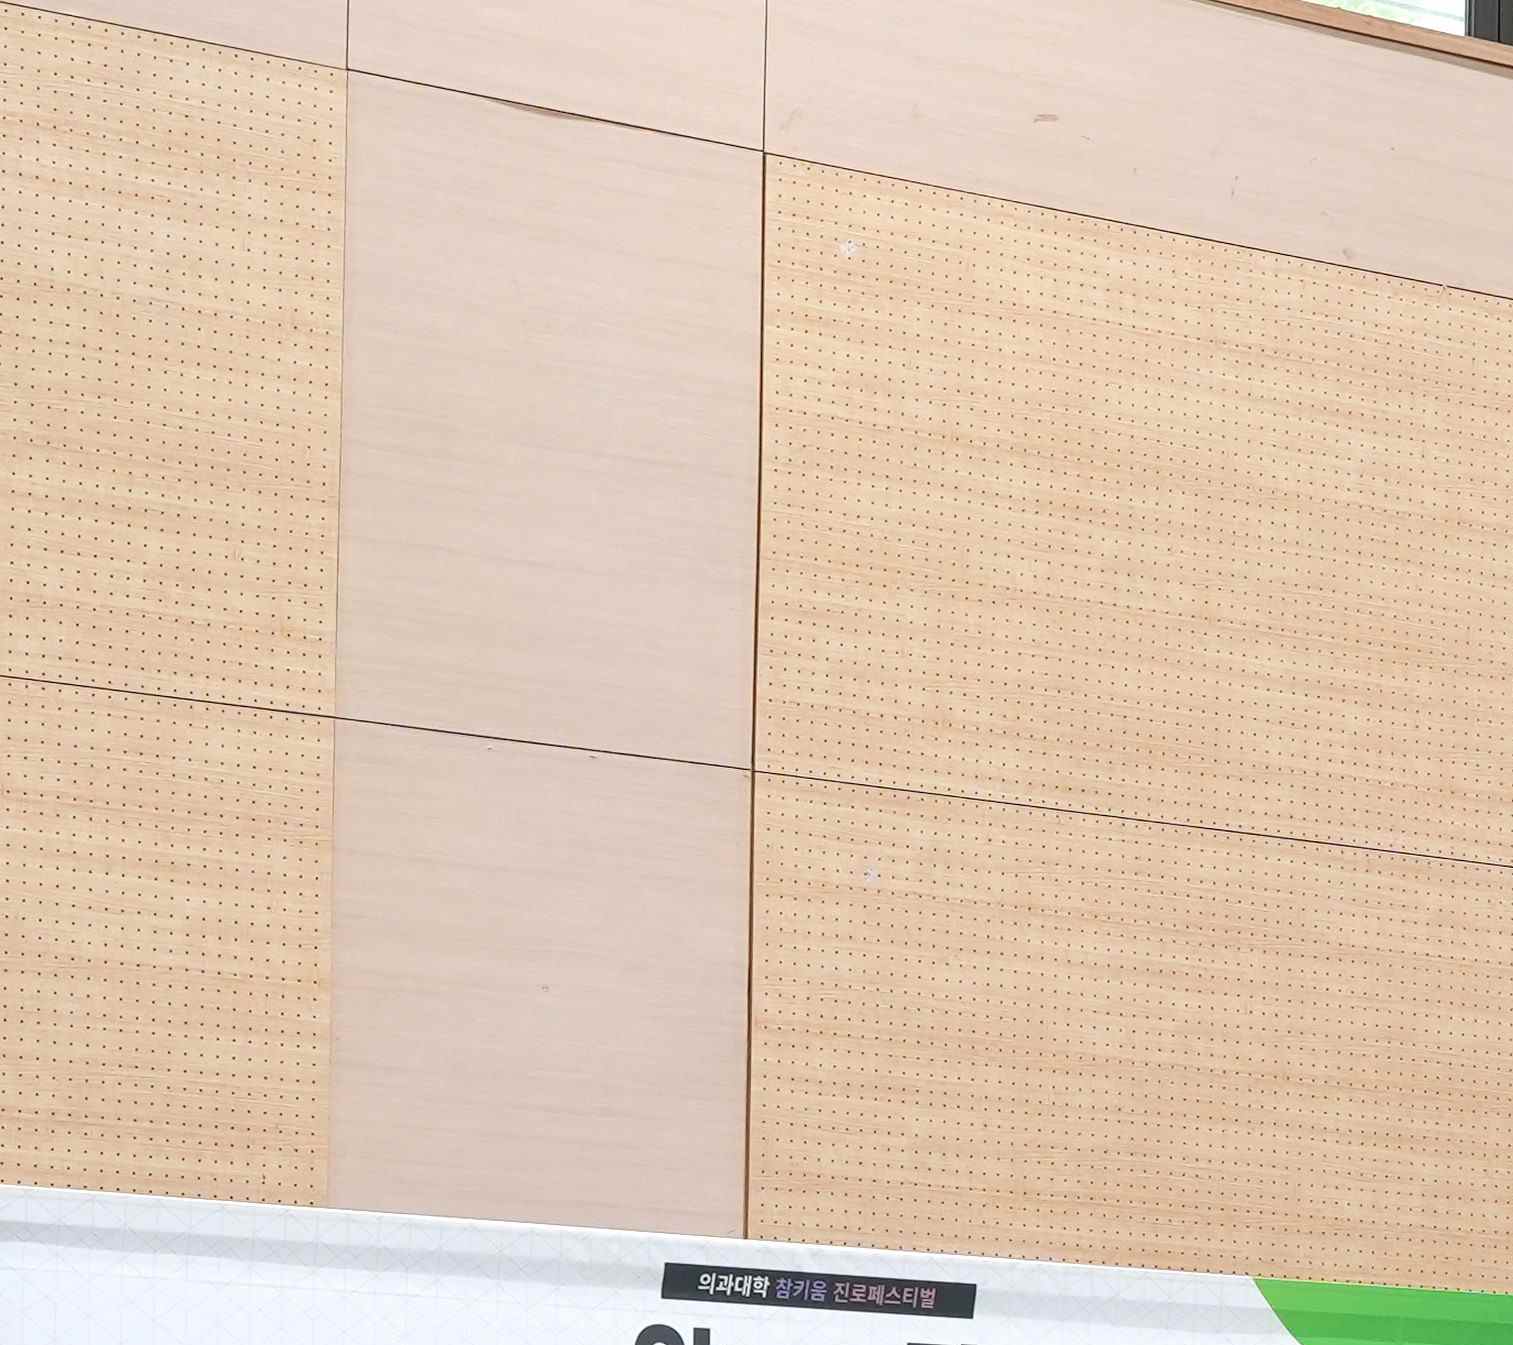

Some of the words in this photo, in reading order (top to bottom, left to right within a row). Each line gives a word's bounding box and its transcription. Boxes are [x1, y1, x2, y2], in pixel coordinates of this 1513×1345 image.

[698, 1273, 770, 1298] 의과대학
[776, 1278, 827, 1301] 참키움
[834, 1282, 936, 1308] 진로페스티벌
